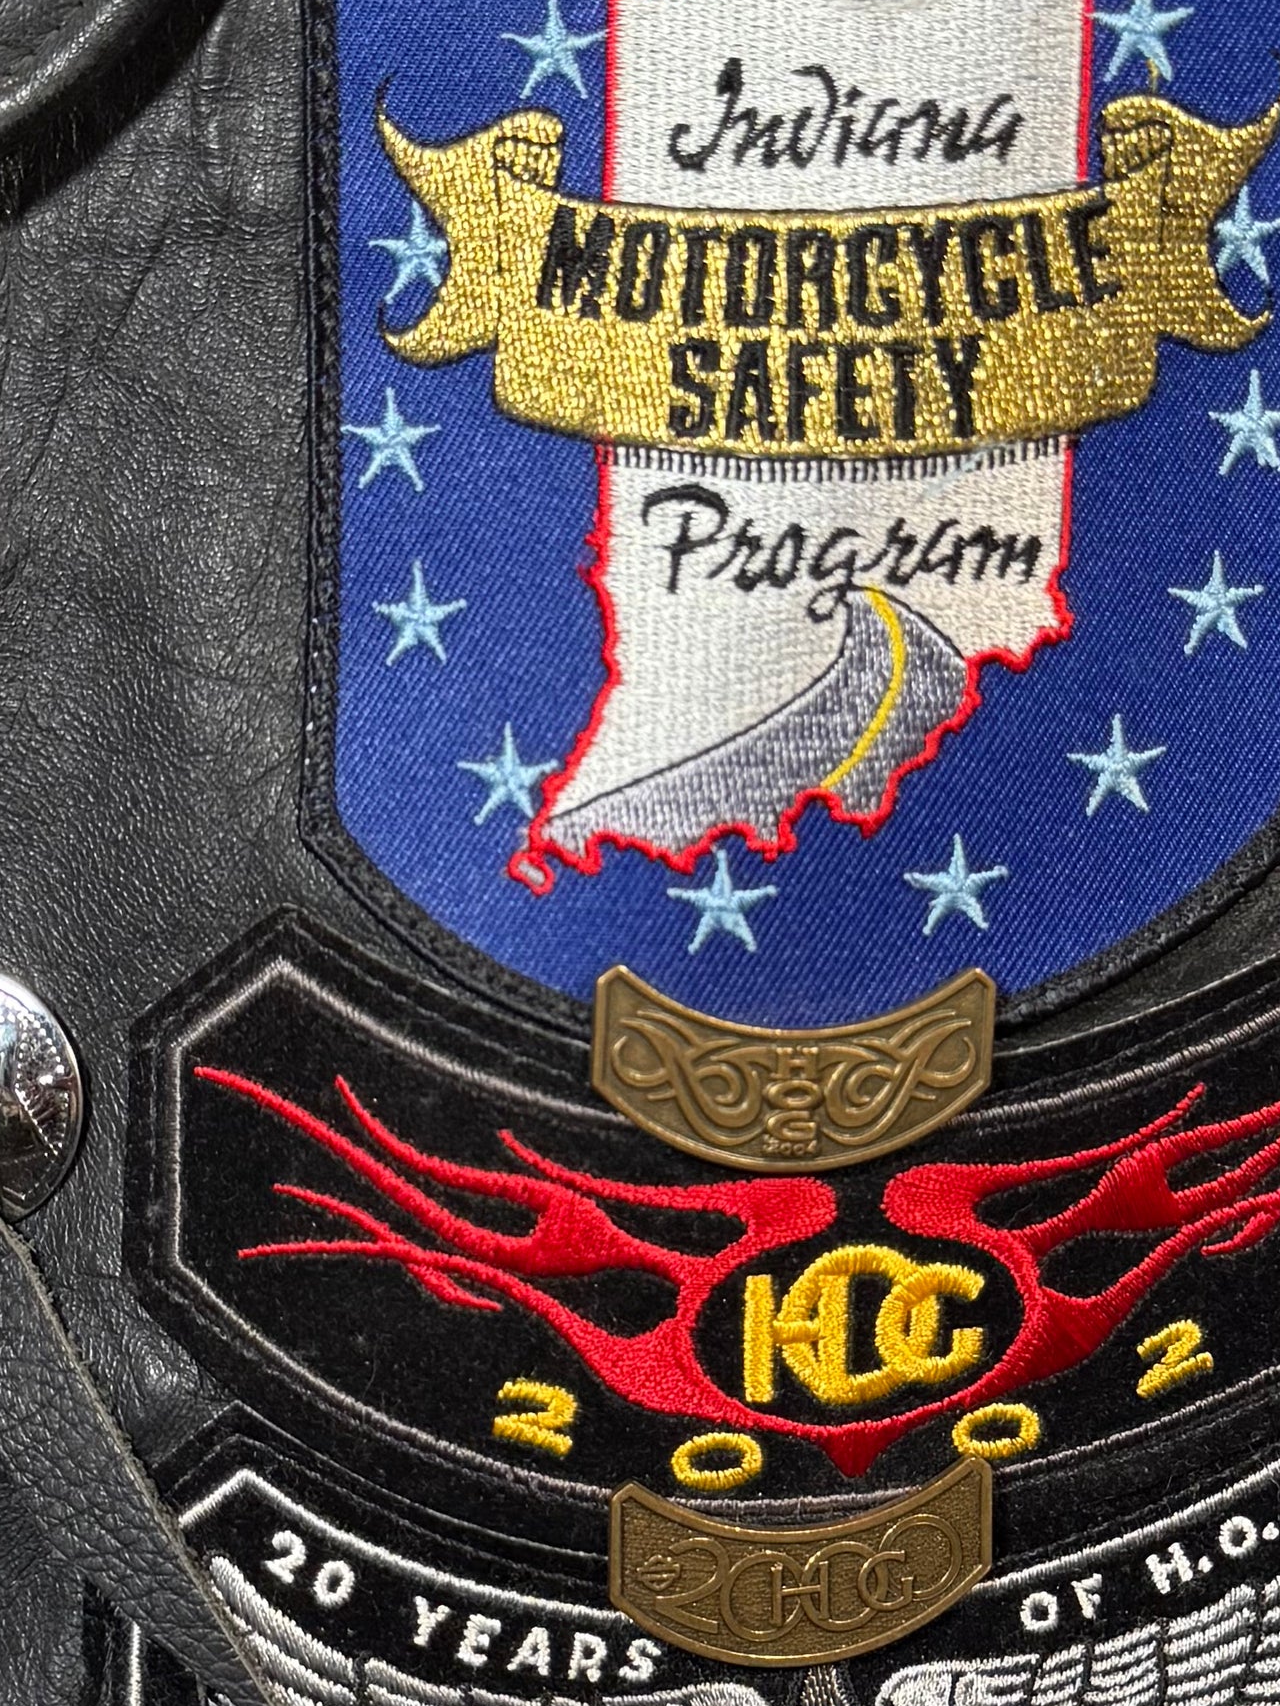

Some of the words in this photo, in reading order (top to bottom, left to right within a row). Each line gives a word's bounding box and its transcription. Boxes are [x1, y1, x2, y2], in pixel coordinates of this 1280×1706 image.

[666, 56, 1025, 173] Indiana
[535, 195, 1120, 327] MOTORCYCLE
[668, 336, 985, 441] SAFETY
[640, 482, 1043, 624] Program
[265, 1530, 356, 1611] 20
[411, 1601, 665, 1687] YEARS
[1018, 1573, 1106, 1629] OF
